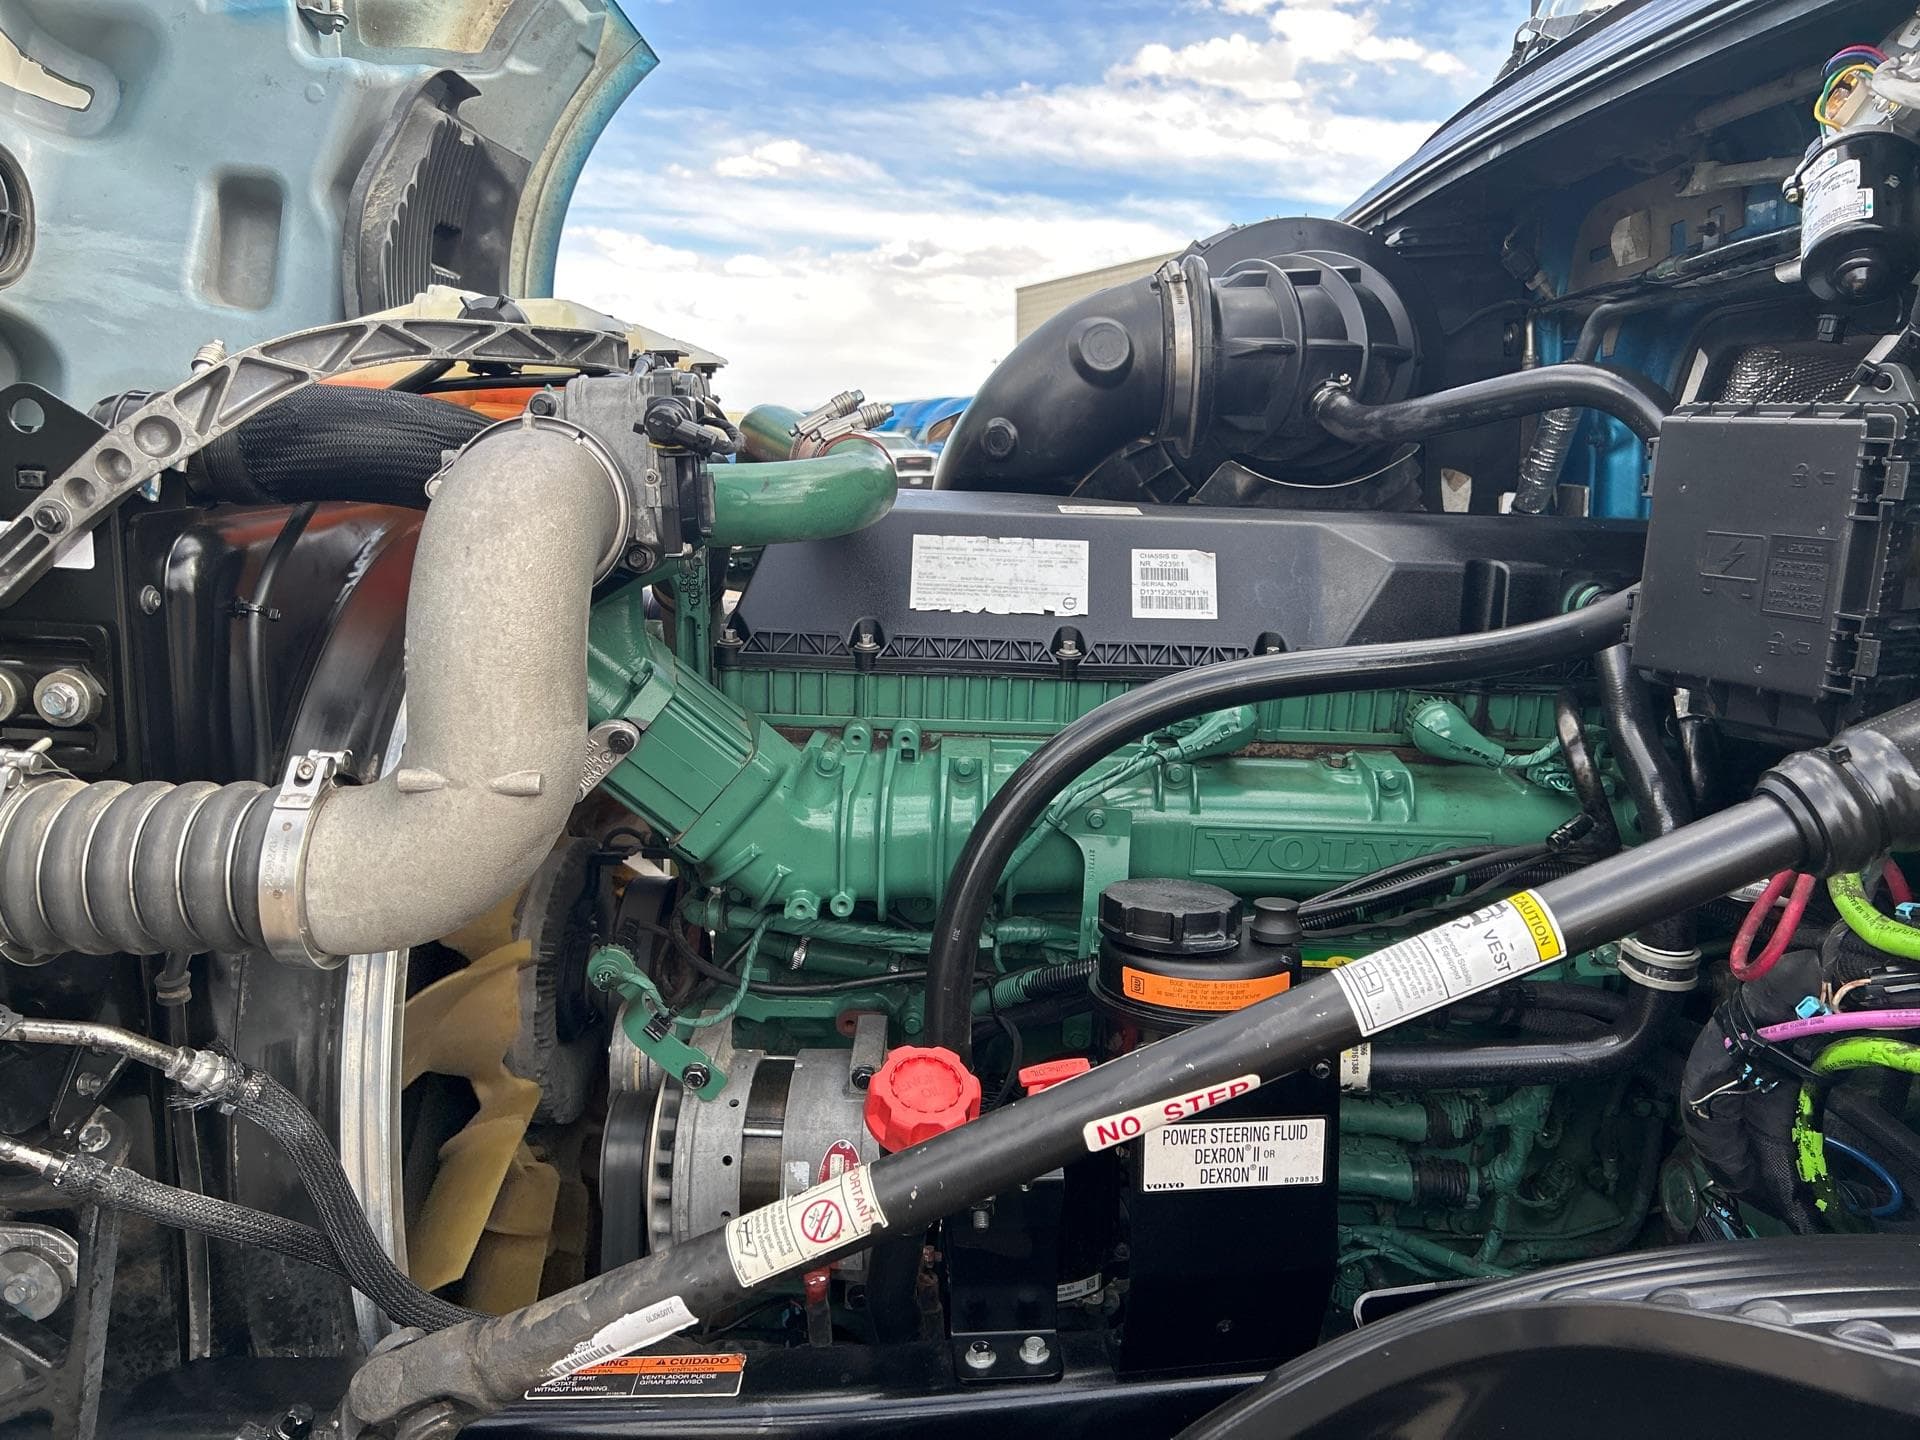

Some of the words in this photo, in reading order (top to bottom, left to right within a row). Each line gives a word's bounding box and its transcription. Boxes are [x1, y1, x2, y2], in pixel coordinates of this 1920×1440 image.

[1204, 832, 1472, 875] VOLV
[1513, 895, 1551, 947] CAUTION
[1483, 928, 1512, 972] VEST
[1096, 1116, 1141, 1146] NO
[1163, 1081, 1251, 1122] STEP
[1162, 1128, 1207, 1146] POWER
[1210, 1126, 1270, 1144] STEERING
[1274, 1124, 1308, 1141] FLUID
[1253, 1146, 1260, 1162] II
[1263, 1149, 1276, 1159] OR
[1258, 1166, 1269, 1182] III
[1146, 1182, 1185, 1191] VOLVO
[669, 1357, 730, 1366] CUIDADO
